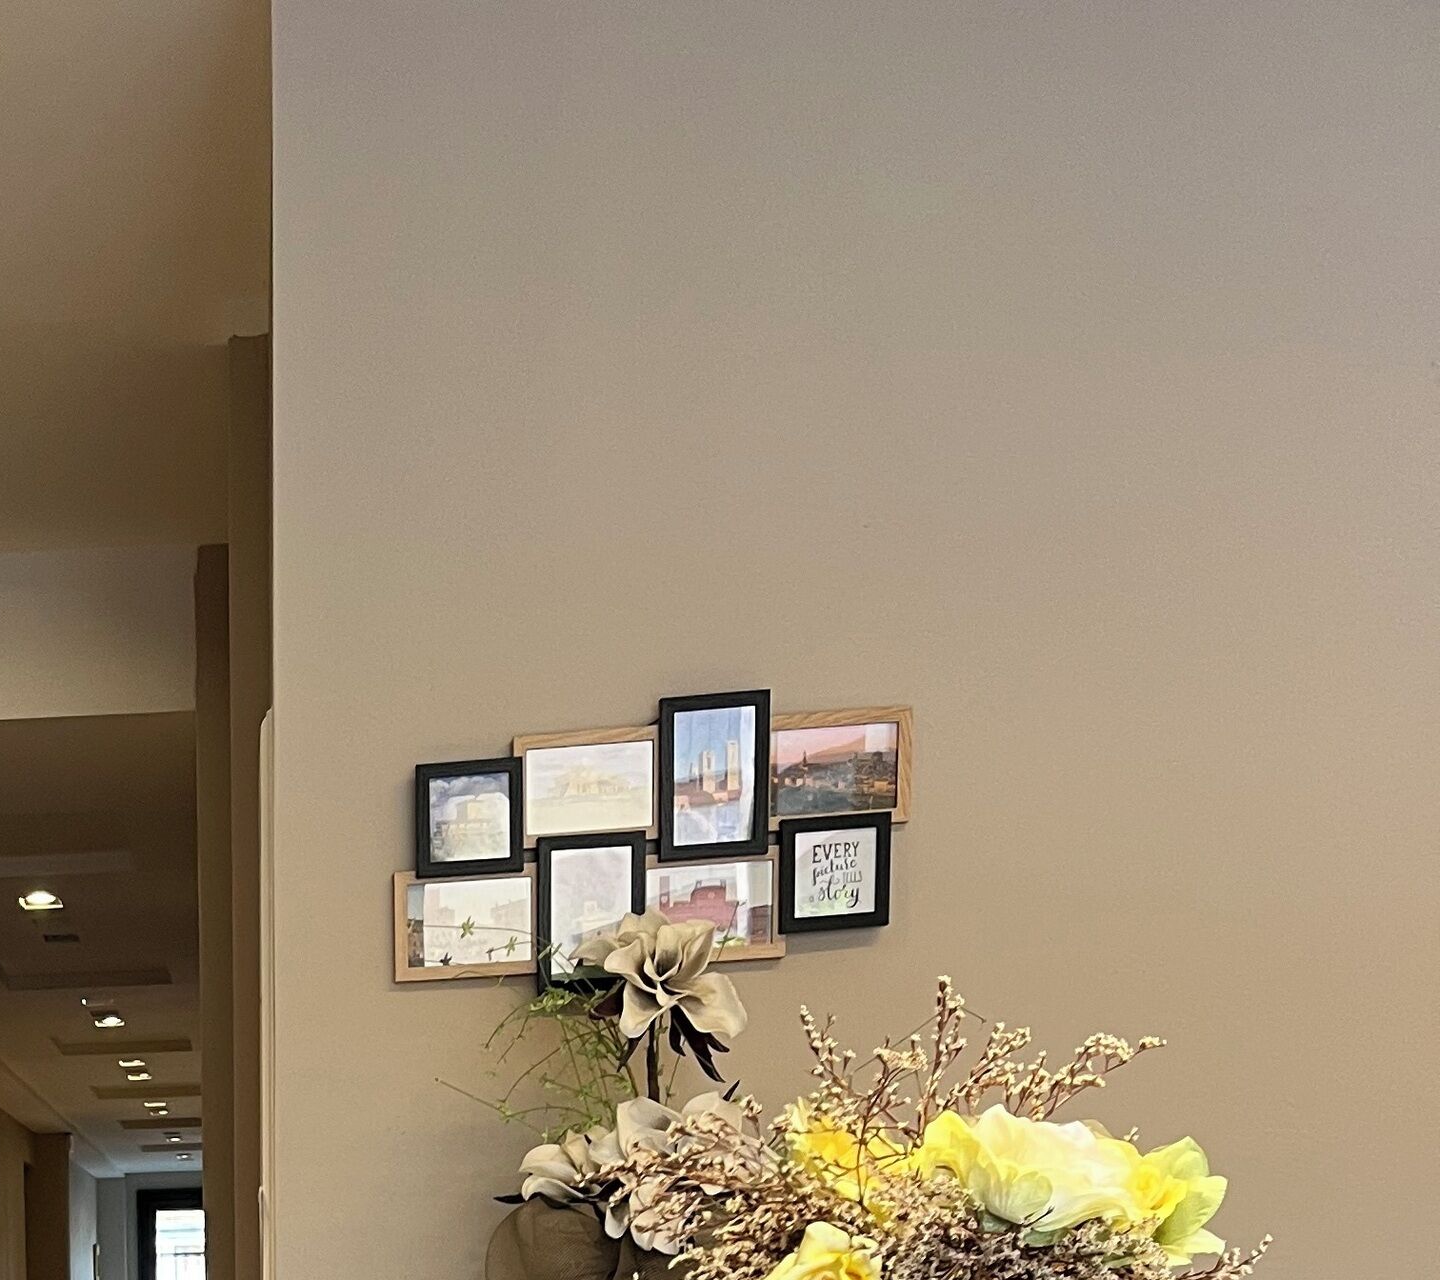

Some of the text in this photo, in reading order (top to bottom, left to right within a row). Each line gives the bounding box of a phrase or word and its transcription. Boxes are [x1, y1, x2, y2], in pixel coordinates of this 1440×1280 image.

[812, 841, 859, 863] EVERY
[812, 858, 857, 886] picture
[818, 875, 860, 909] story
